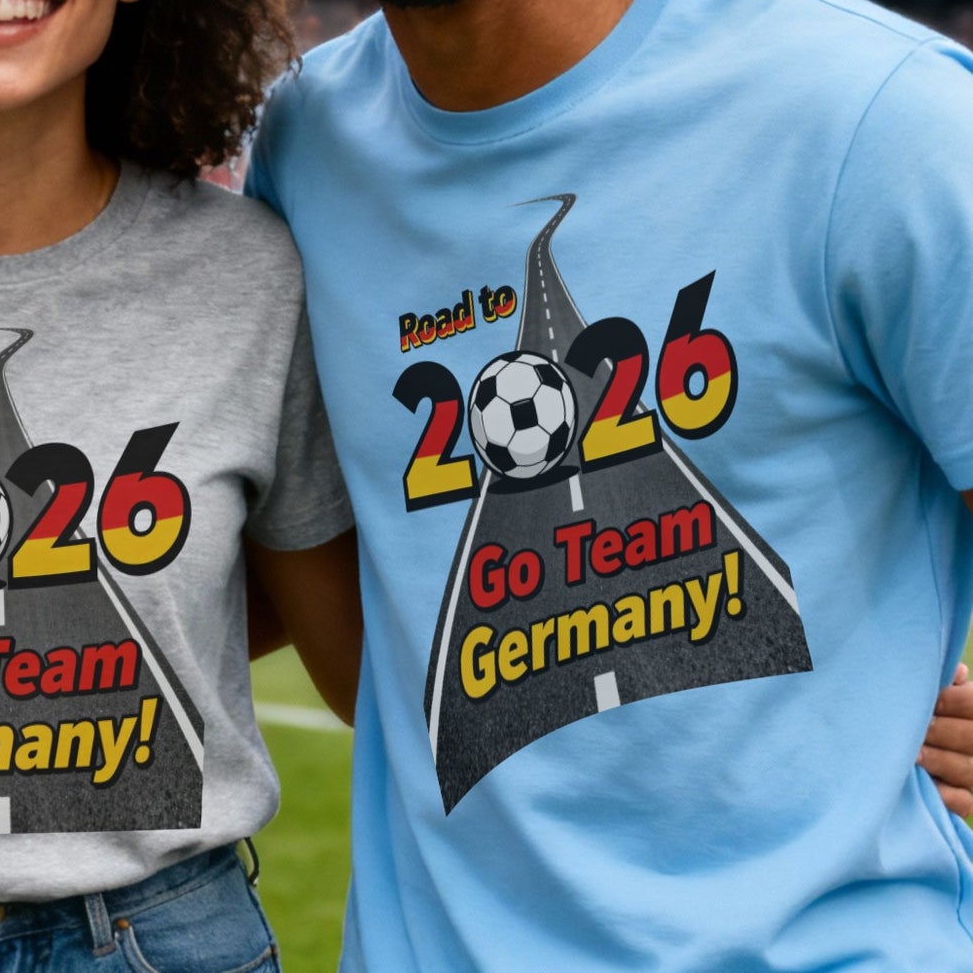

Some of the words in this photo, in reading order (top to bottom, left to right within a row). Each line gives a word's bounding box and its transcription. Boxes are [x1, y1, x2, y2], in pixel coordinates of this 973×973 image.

[399, 290, 475, 352] Road
[479, 284, 517, 323] to
[467, 541, 544, 610] Go
[554, 499, 717, 585] Team
[460, 552, 747, 700] Germany!
